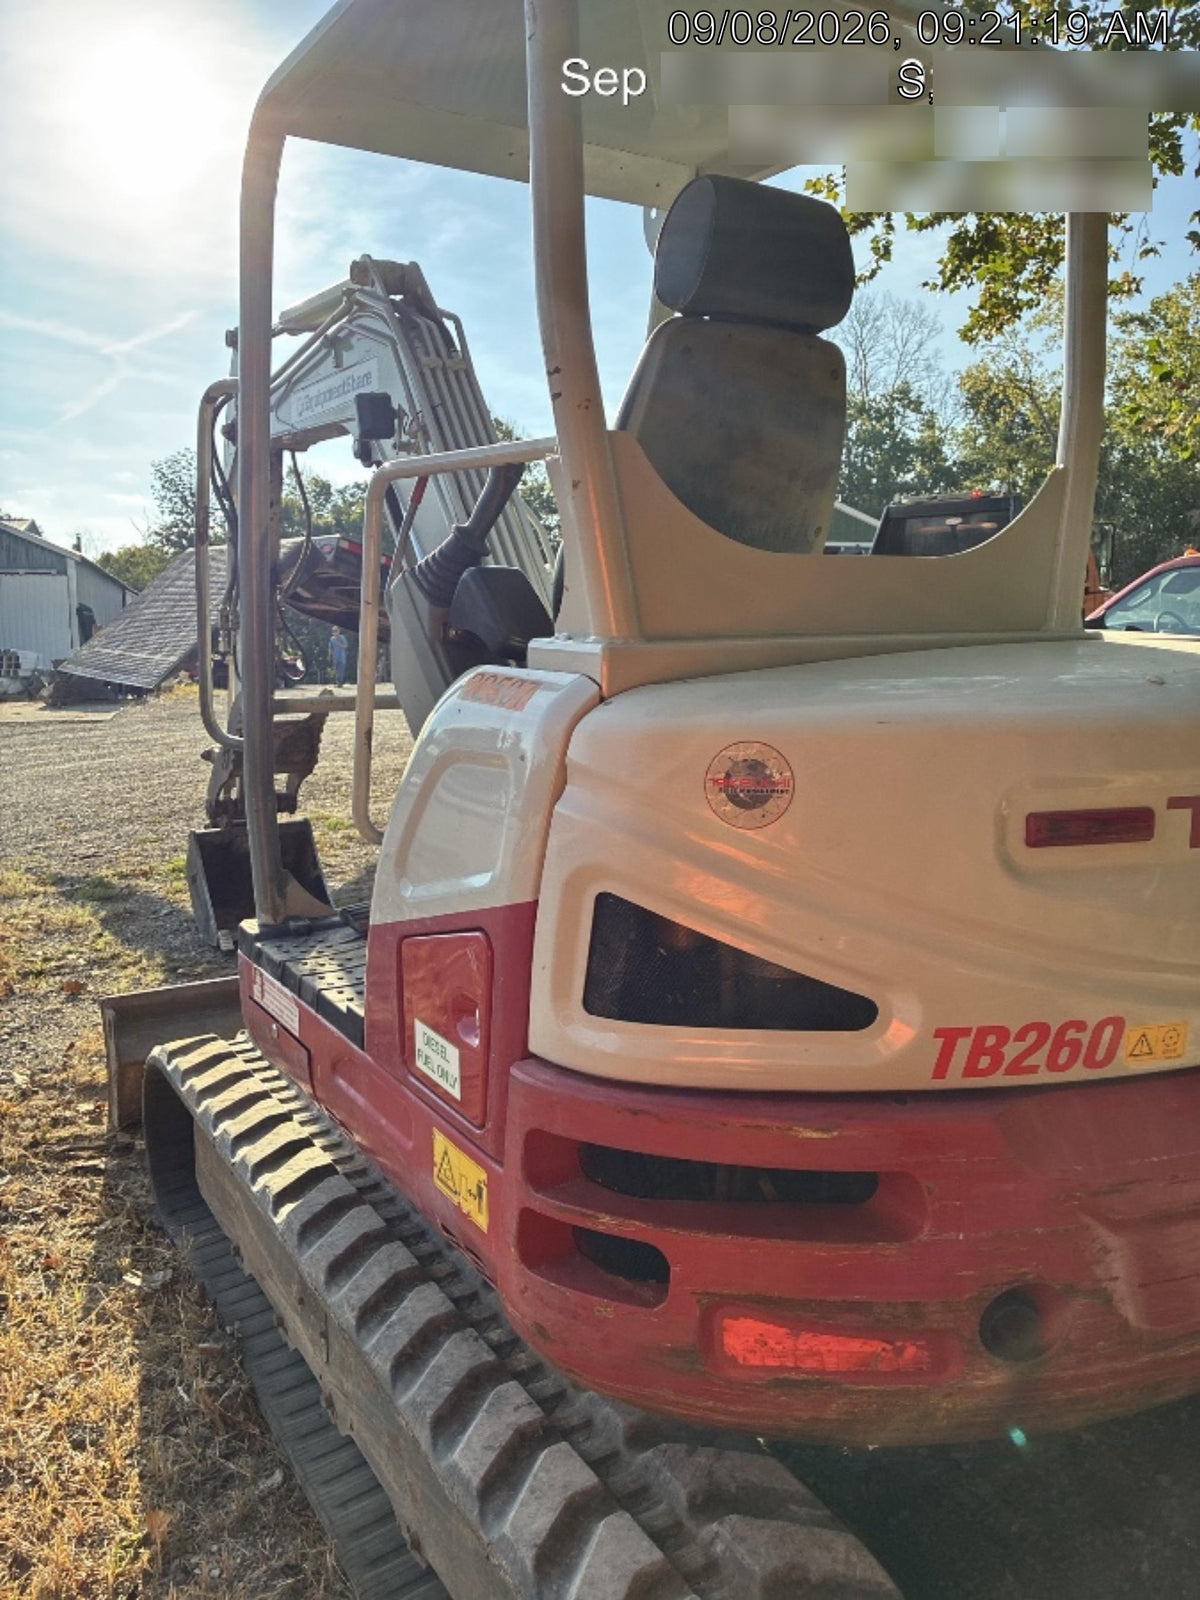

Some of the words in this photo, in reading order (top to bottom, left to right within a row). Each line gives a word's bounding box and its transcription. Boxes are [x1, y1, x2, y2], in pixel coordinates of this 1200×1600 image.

[417, 1047, 436, 1075] FUEL
[436, 1064, 458, 1090] ONLY
[423, 1031, 450, 1064] DIESEL
[931, 1016, 1126, 1080] TB260
